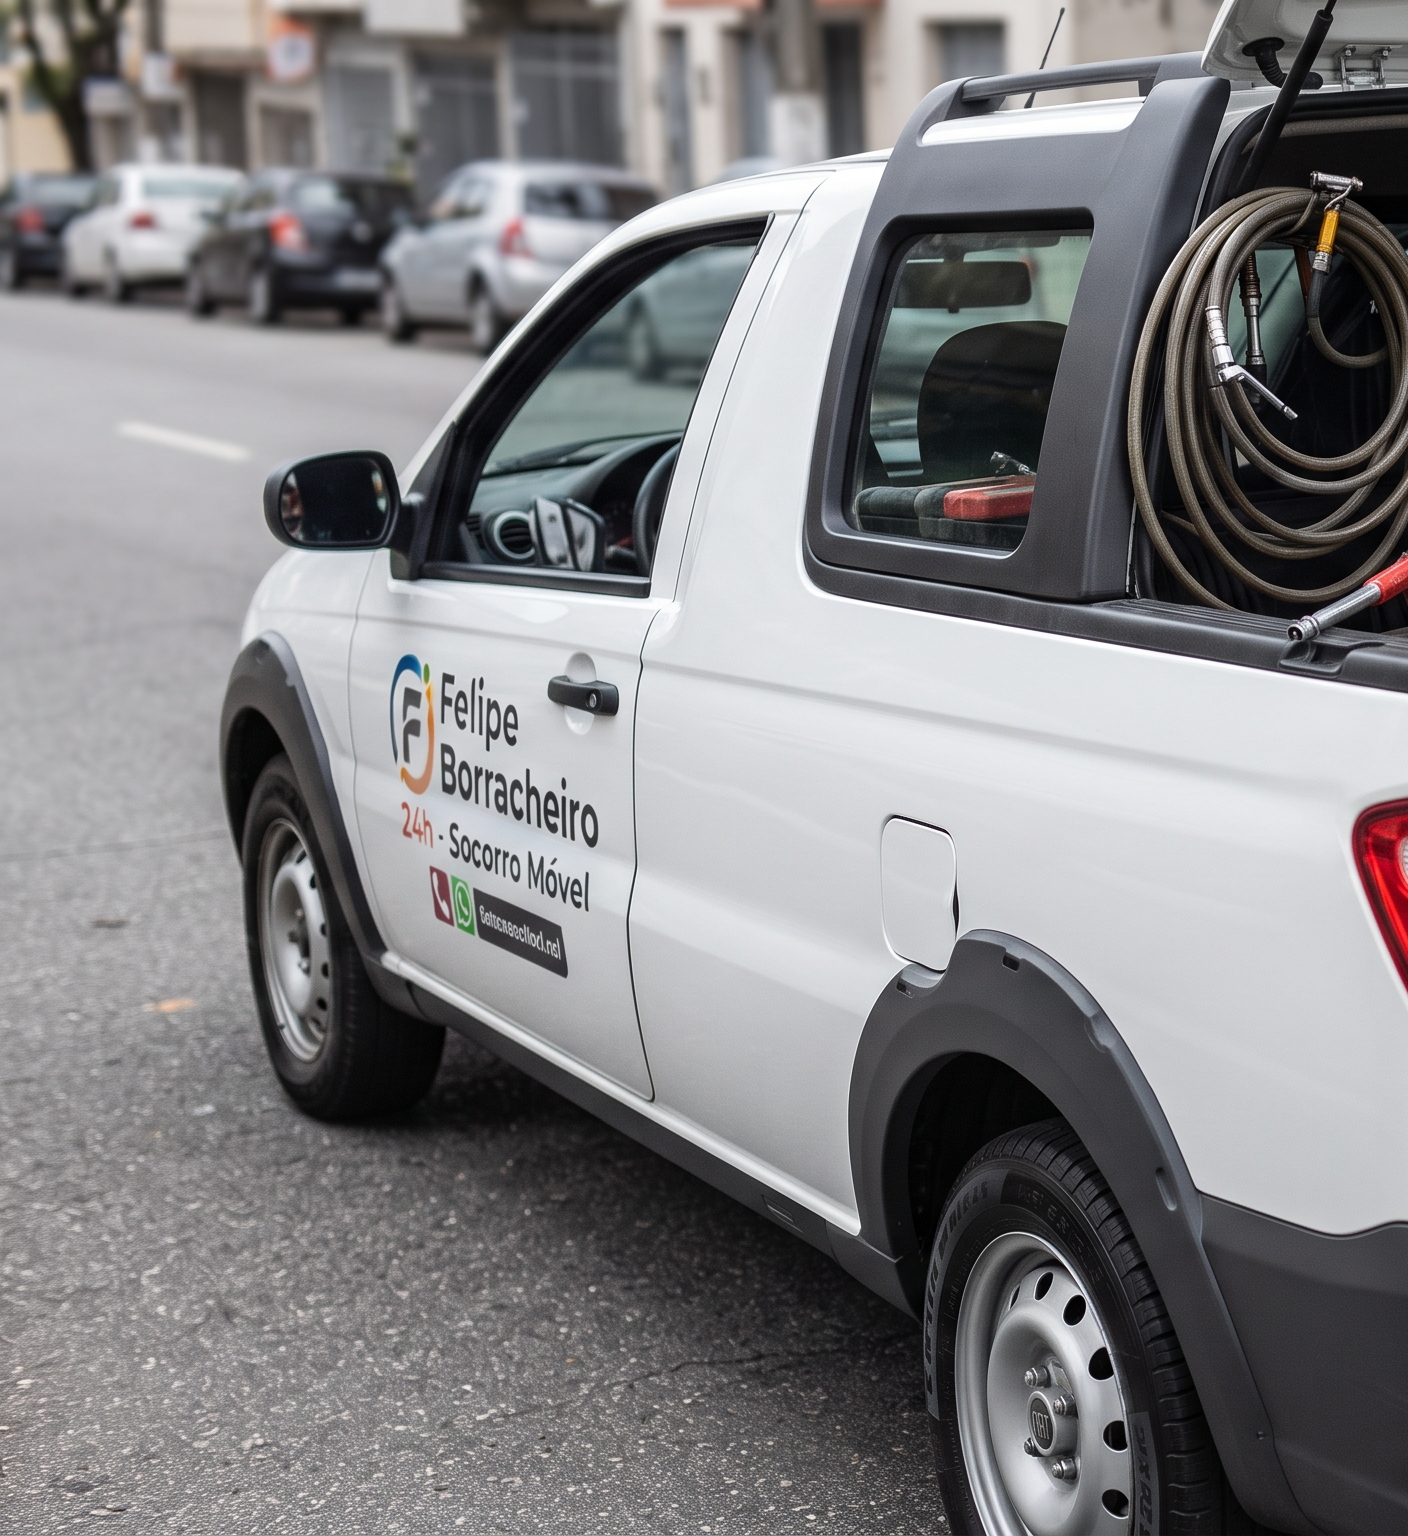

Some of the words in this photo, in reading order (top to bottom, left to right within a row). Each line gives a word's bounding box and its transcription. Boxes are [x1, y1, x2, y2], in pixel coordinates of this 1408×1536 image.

[440, 672, 519, 752] Felipe
[440, 743, 599, 848] Borracheiro
[401, 802, 434, 848] 24h
[449, 822, 521, 882] Socorro
[527, 851, 590, 912] Móvel
